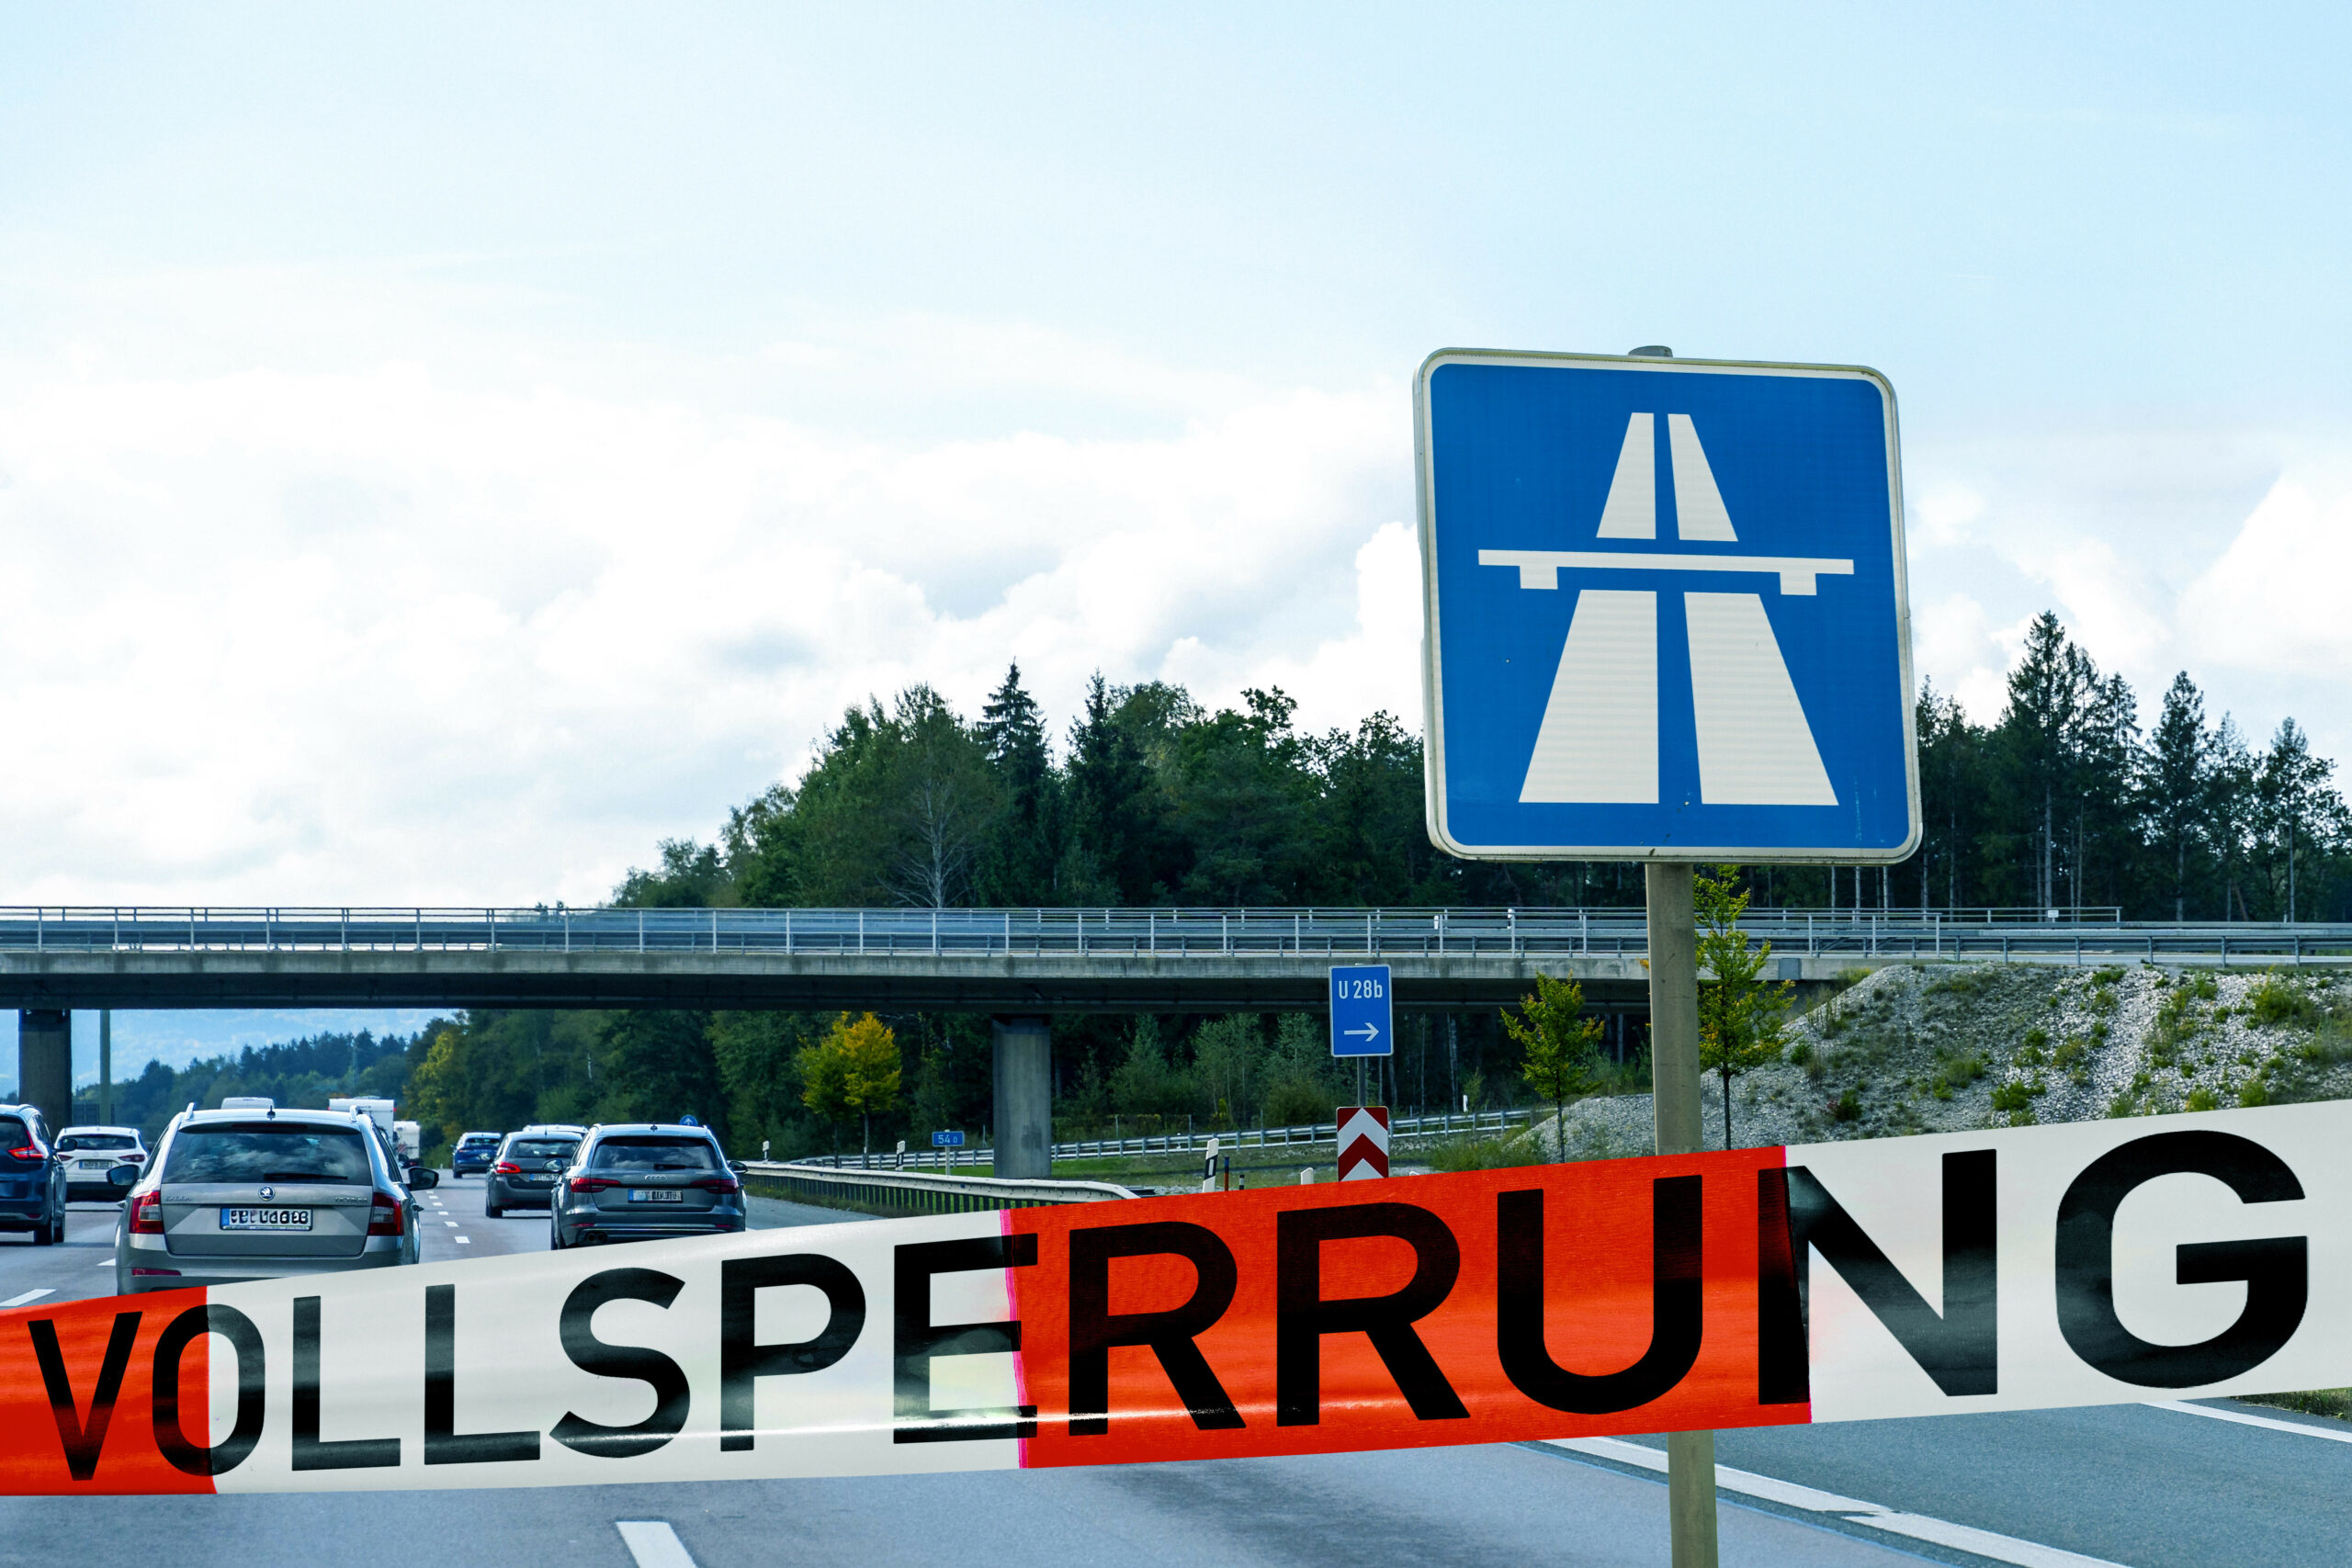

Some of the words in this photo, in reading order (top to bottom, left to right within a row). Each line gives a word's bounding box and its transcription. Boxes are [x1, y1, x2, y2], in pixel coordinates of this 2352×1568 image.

[1338, 980, 1349, 999] U
[1352, 978, 1383, 999] 28b
[27, 1129, 2309, 1482] VOLLSPERRUNG
